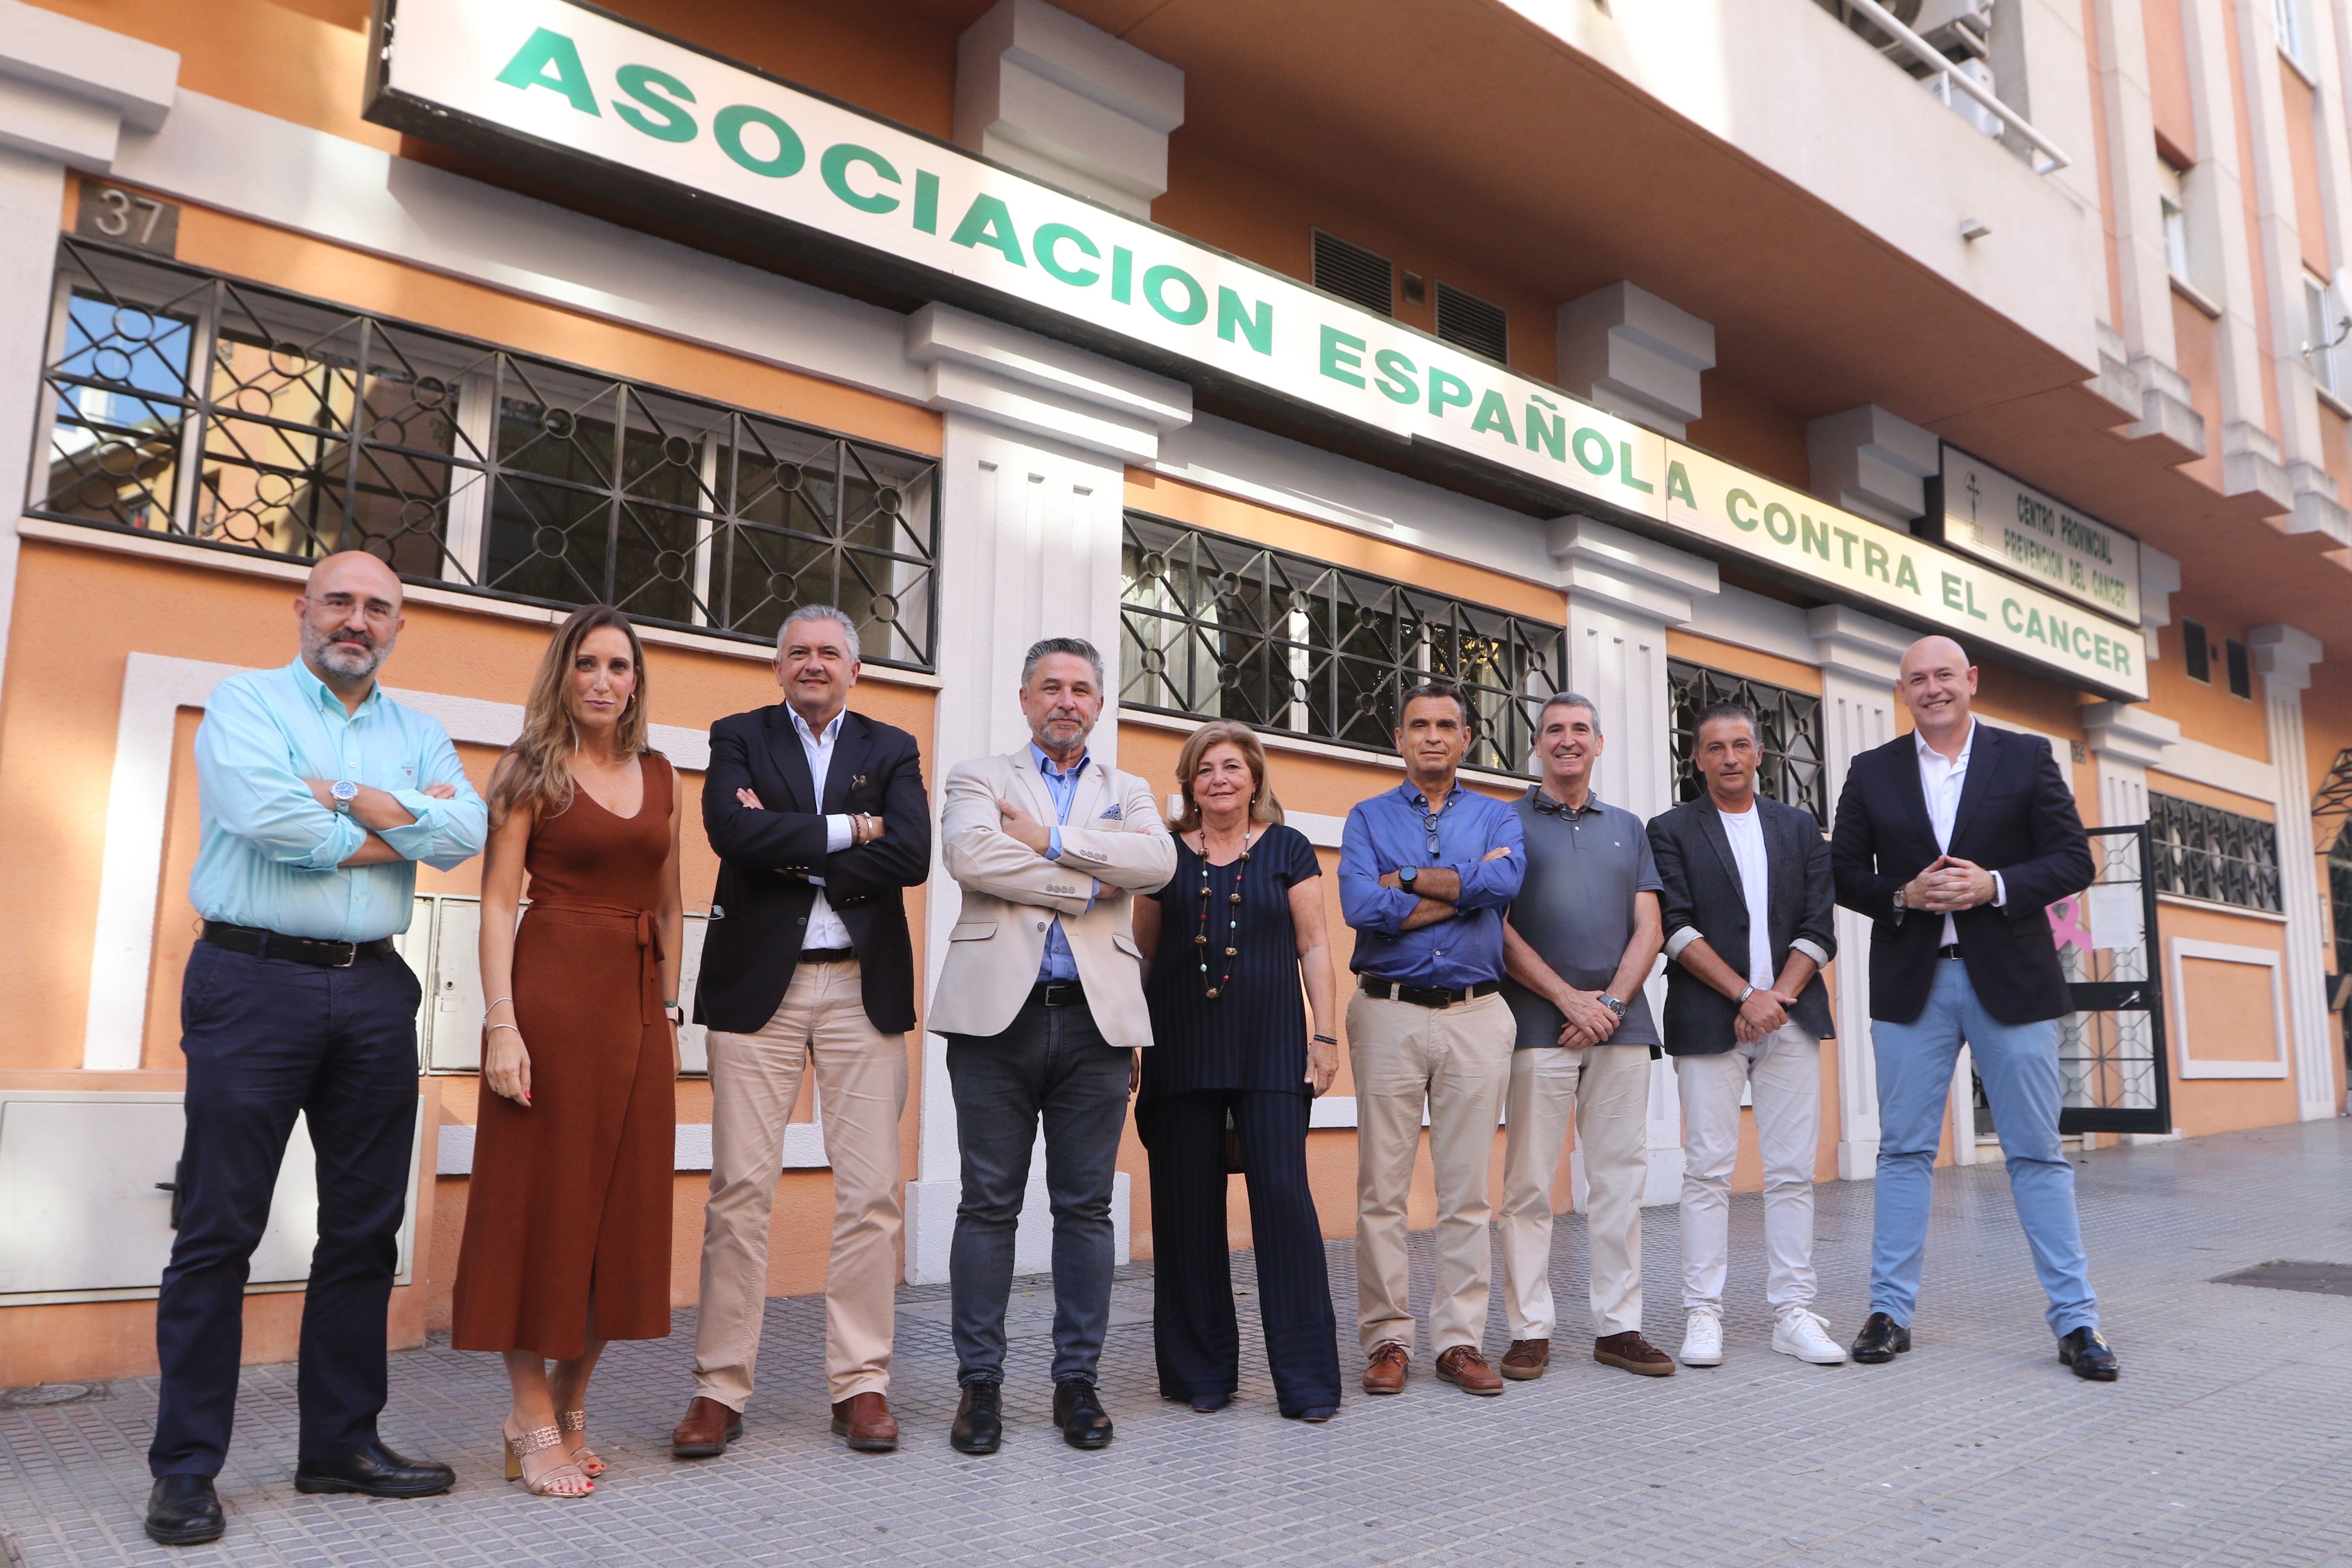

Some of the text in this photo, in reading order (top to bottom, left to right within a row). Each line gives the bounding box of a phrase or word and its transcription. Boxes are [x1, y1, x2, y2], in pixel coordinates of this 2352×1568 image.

[96, 189, 162, 245] 37
[496, 27, 2131, 676] ASOCIACION ESPAÑOLA CONTRA EL CANCER
[2018, 493, 2113, 564] CENTRO PROVINCIAL
[2004, 528, 2127, 609] PREVENCION DEL CANCER
